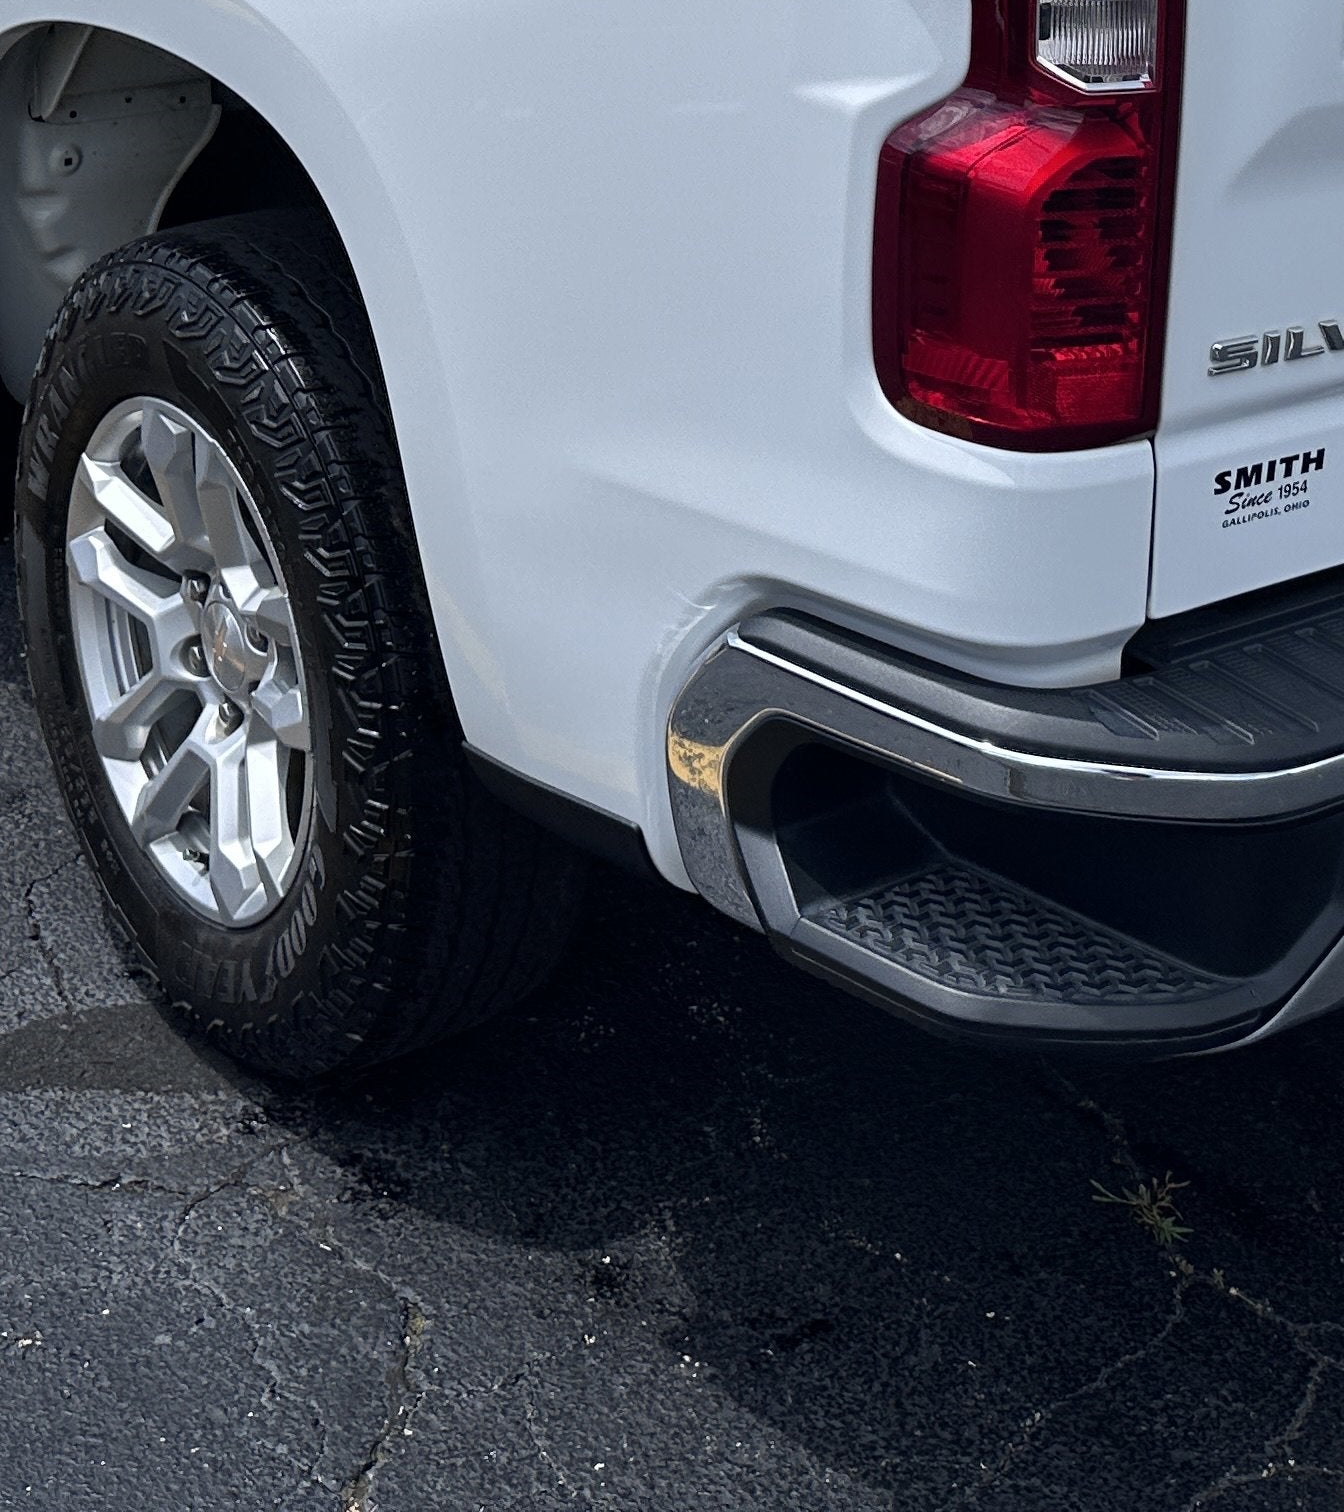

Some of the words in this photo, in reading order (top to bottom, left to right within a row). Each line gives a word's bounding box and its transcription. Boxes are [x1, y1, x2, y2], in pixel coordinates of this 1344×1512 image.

[1213, 448, 1326, 496] SMITH
[1224, 490, 1273, 515] Since
[1277, 479, 1308, 500] 1954
[1283, 499, 1311, 513] OHIO
